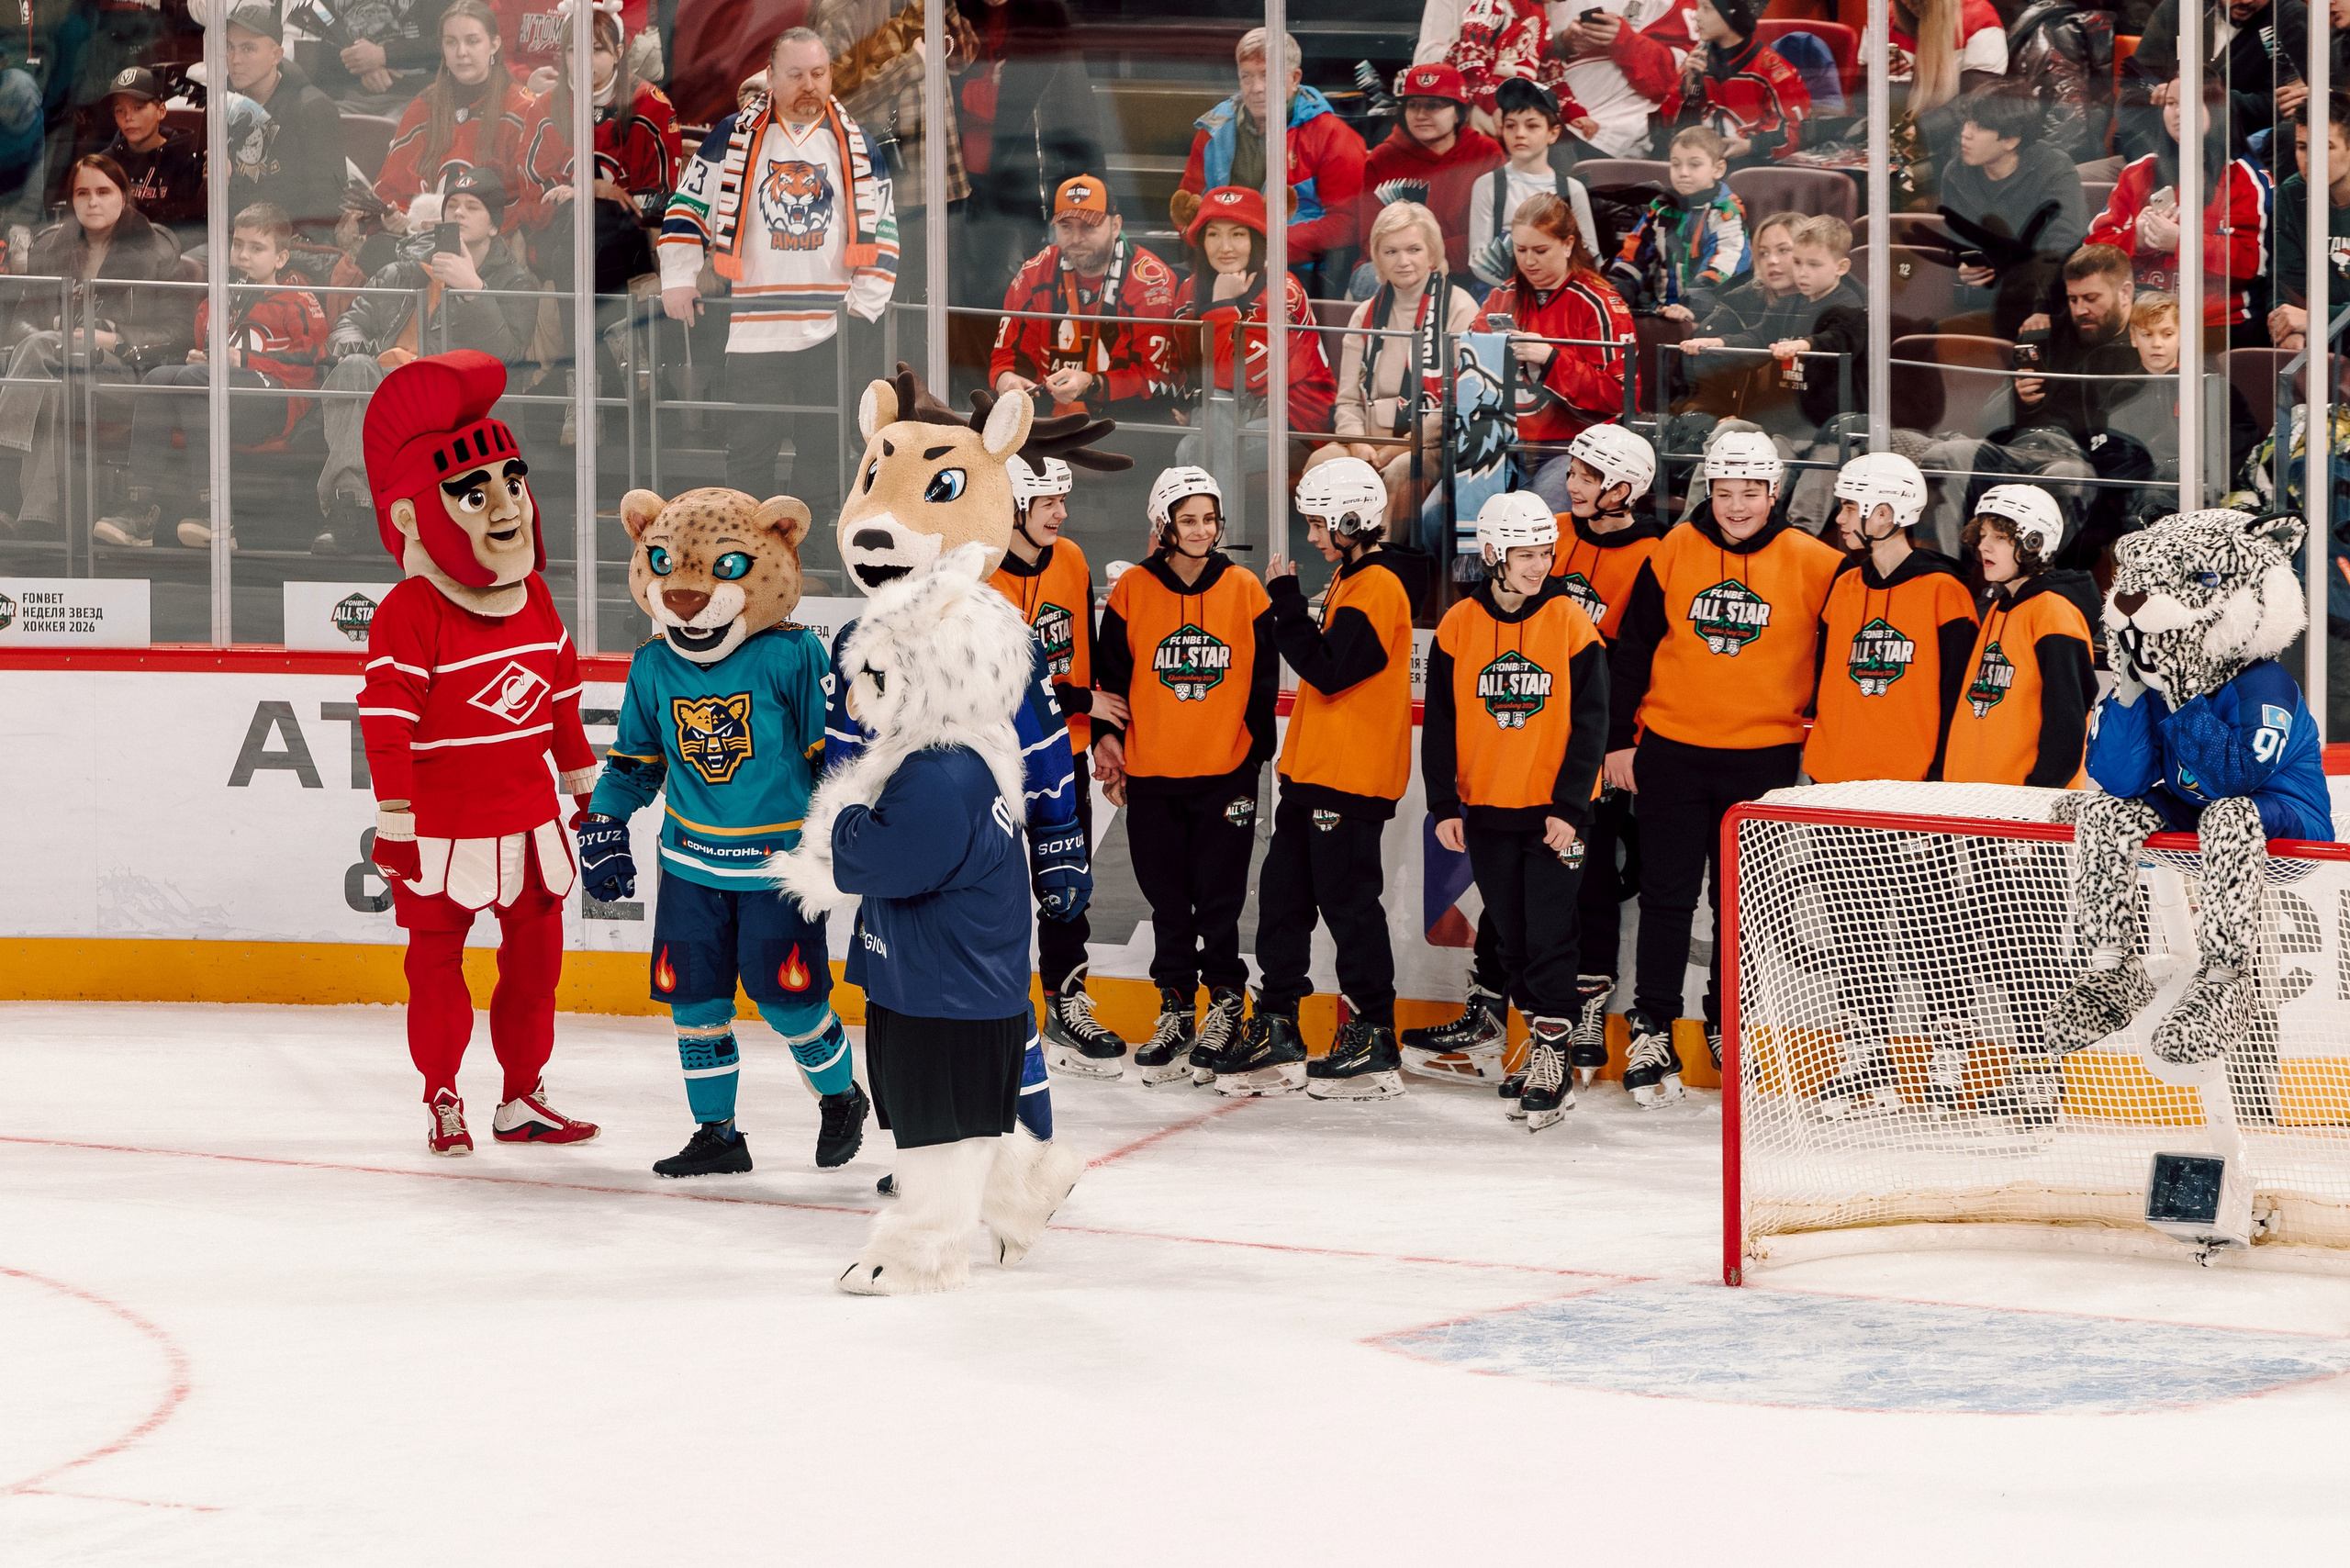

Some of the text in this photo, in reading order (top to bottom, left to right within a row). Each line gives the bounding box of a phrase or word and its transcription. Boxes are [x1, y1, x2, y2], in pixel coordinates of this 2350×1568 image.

[681, 159, 708, 196] 3
[22, 592, 64, 604] FONBET
[344, 599, 370, 607] FONBET
[22, 607, 104, 621] НЕДЕЛЯ ЗВЕЗД
[332, 606, 375, 622] ALL STA
[1035, 610, 1063, 628] FONBET
[1689, 597, 1771, 626] ALL STAR
[22, 621, 95, 633] ХОККЕЯ 2026
[808, 625, 830, 639] ЕЗД
[1154, 646, 1231, 670] ALL STAR
[1849, 641, 1915, 664] ALL STAR
[1478, 673, 1551, 697] ALL STAR
[1986, 664, 2015, 688] STAR
[578, 829, 622, 848] OYUZ
[864, 933, 888, 958] GION
